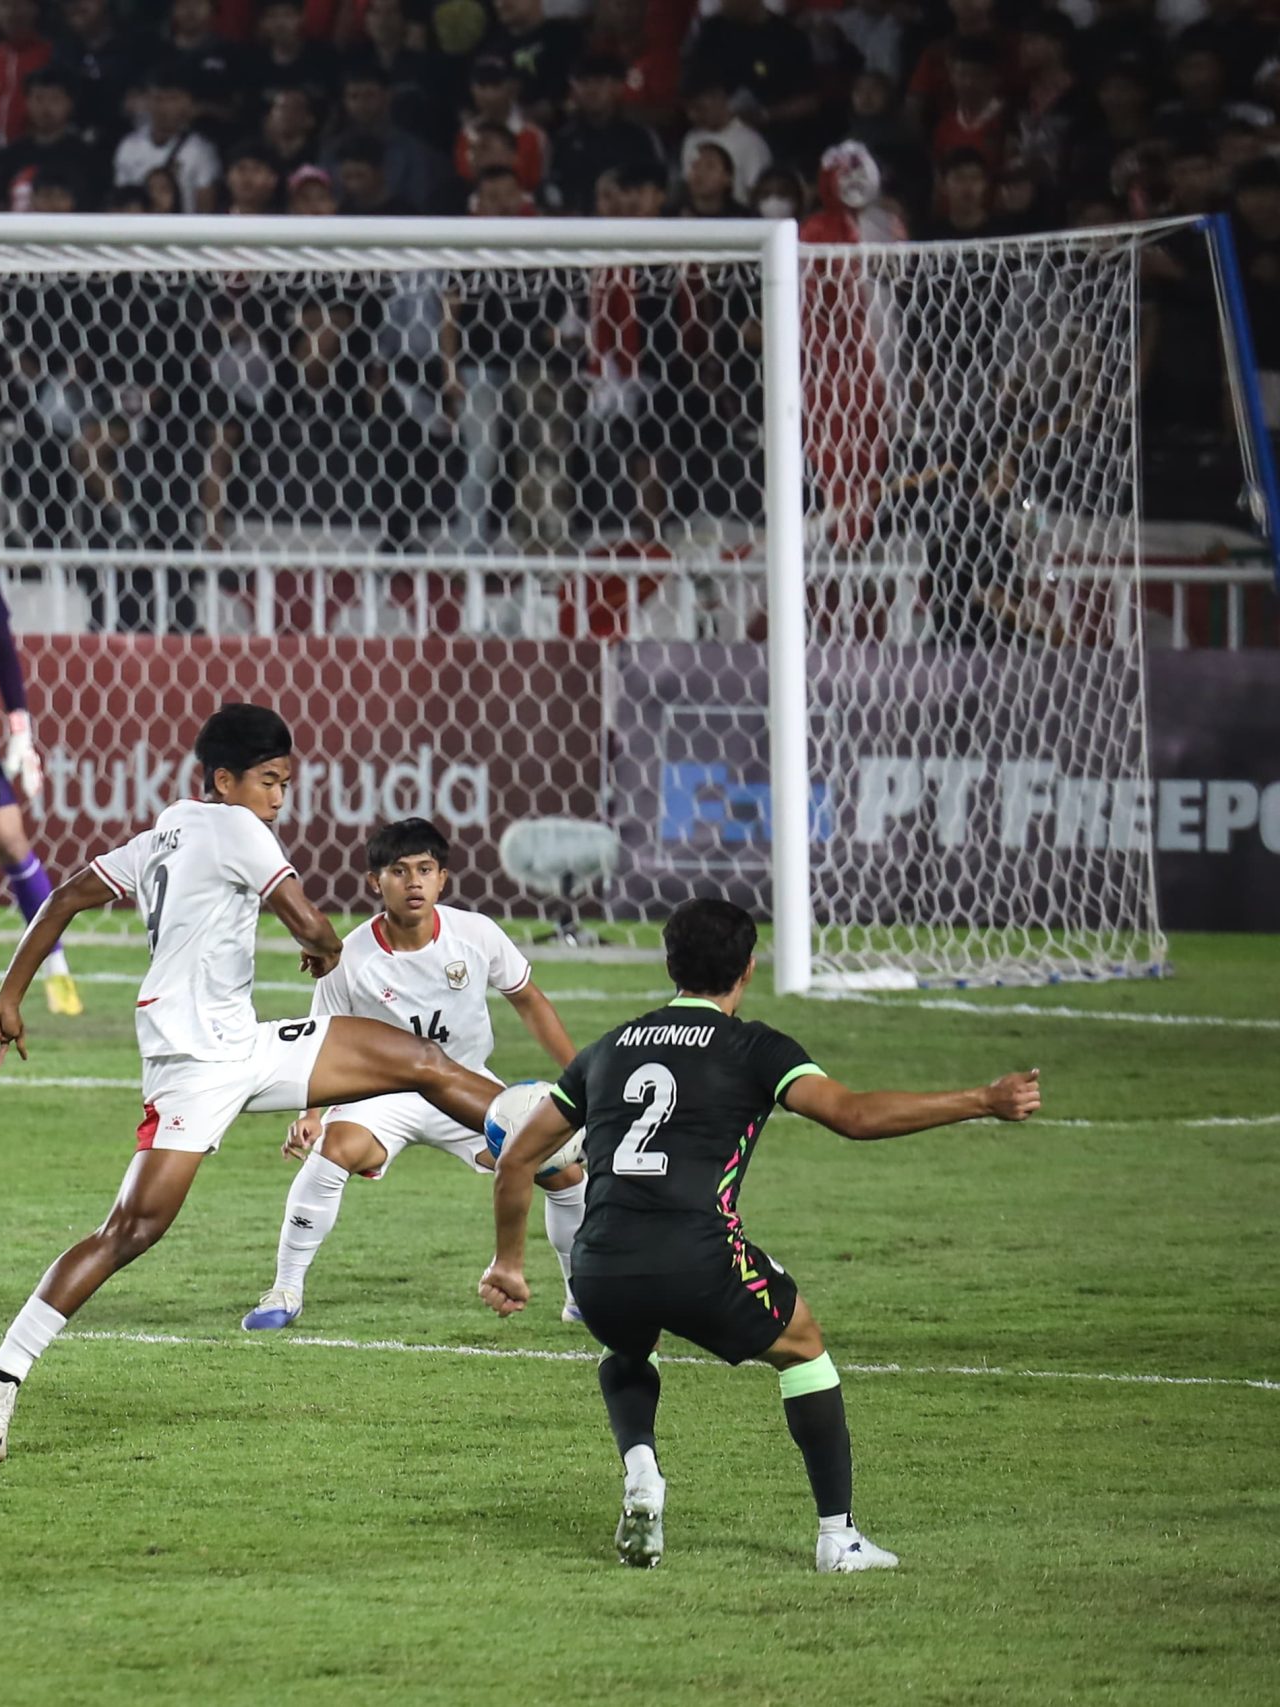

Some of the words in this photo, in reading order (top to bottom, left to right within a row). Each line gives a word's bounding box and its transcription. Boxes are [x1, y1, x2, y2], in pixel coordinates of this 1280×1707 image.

[855, 757, 984, 847] PT
[147, 864, 168, 962] 9
[410, 1009, 450, 1043] 14
[615, 1024, 716, 1048] ANTONIOU
[612, 1062, 677, 1176] 2
